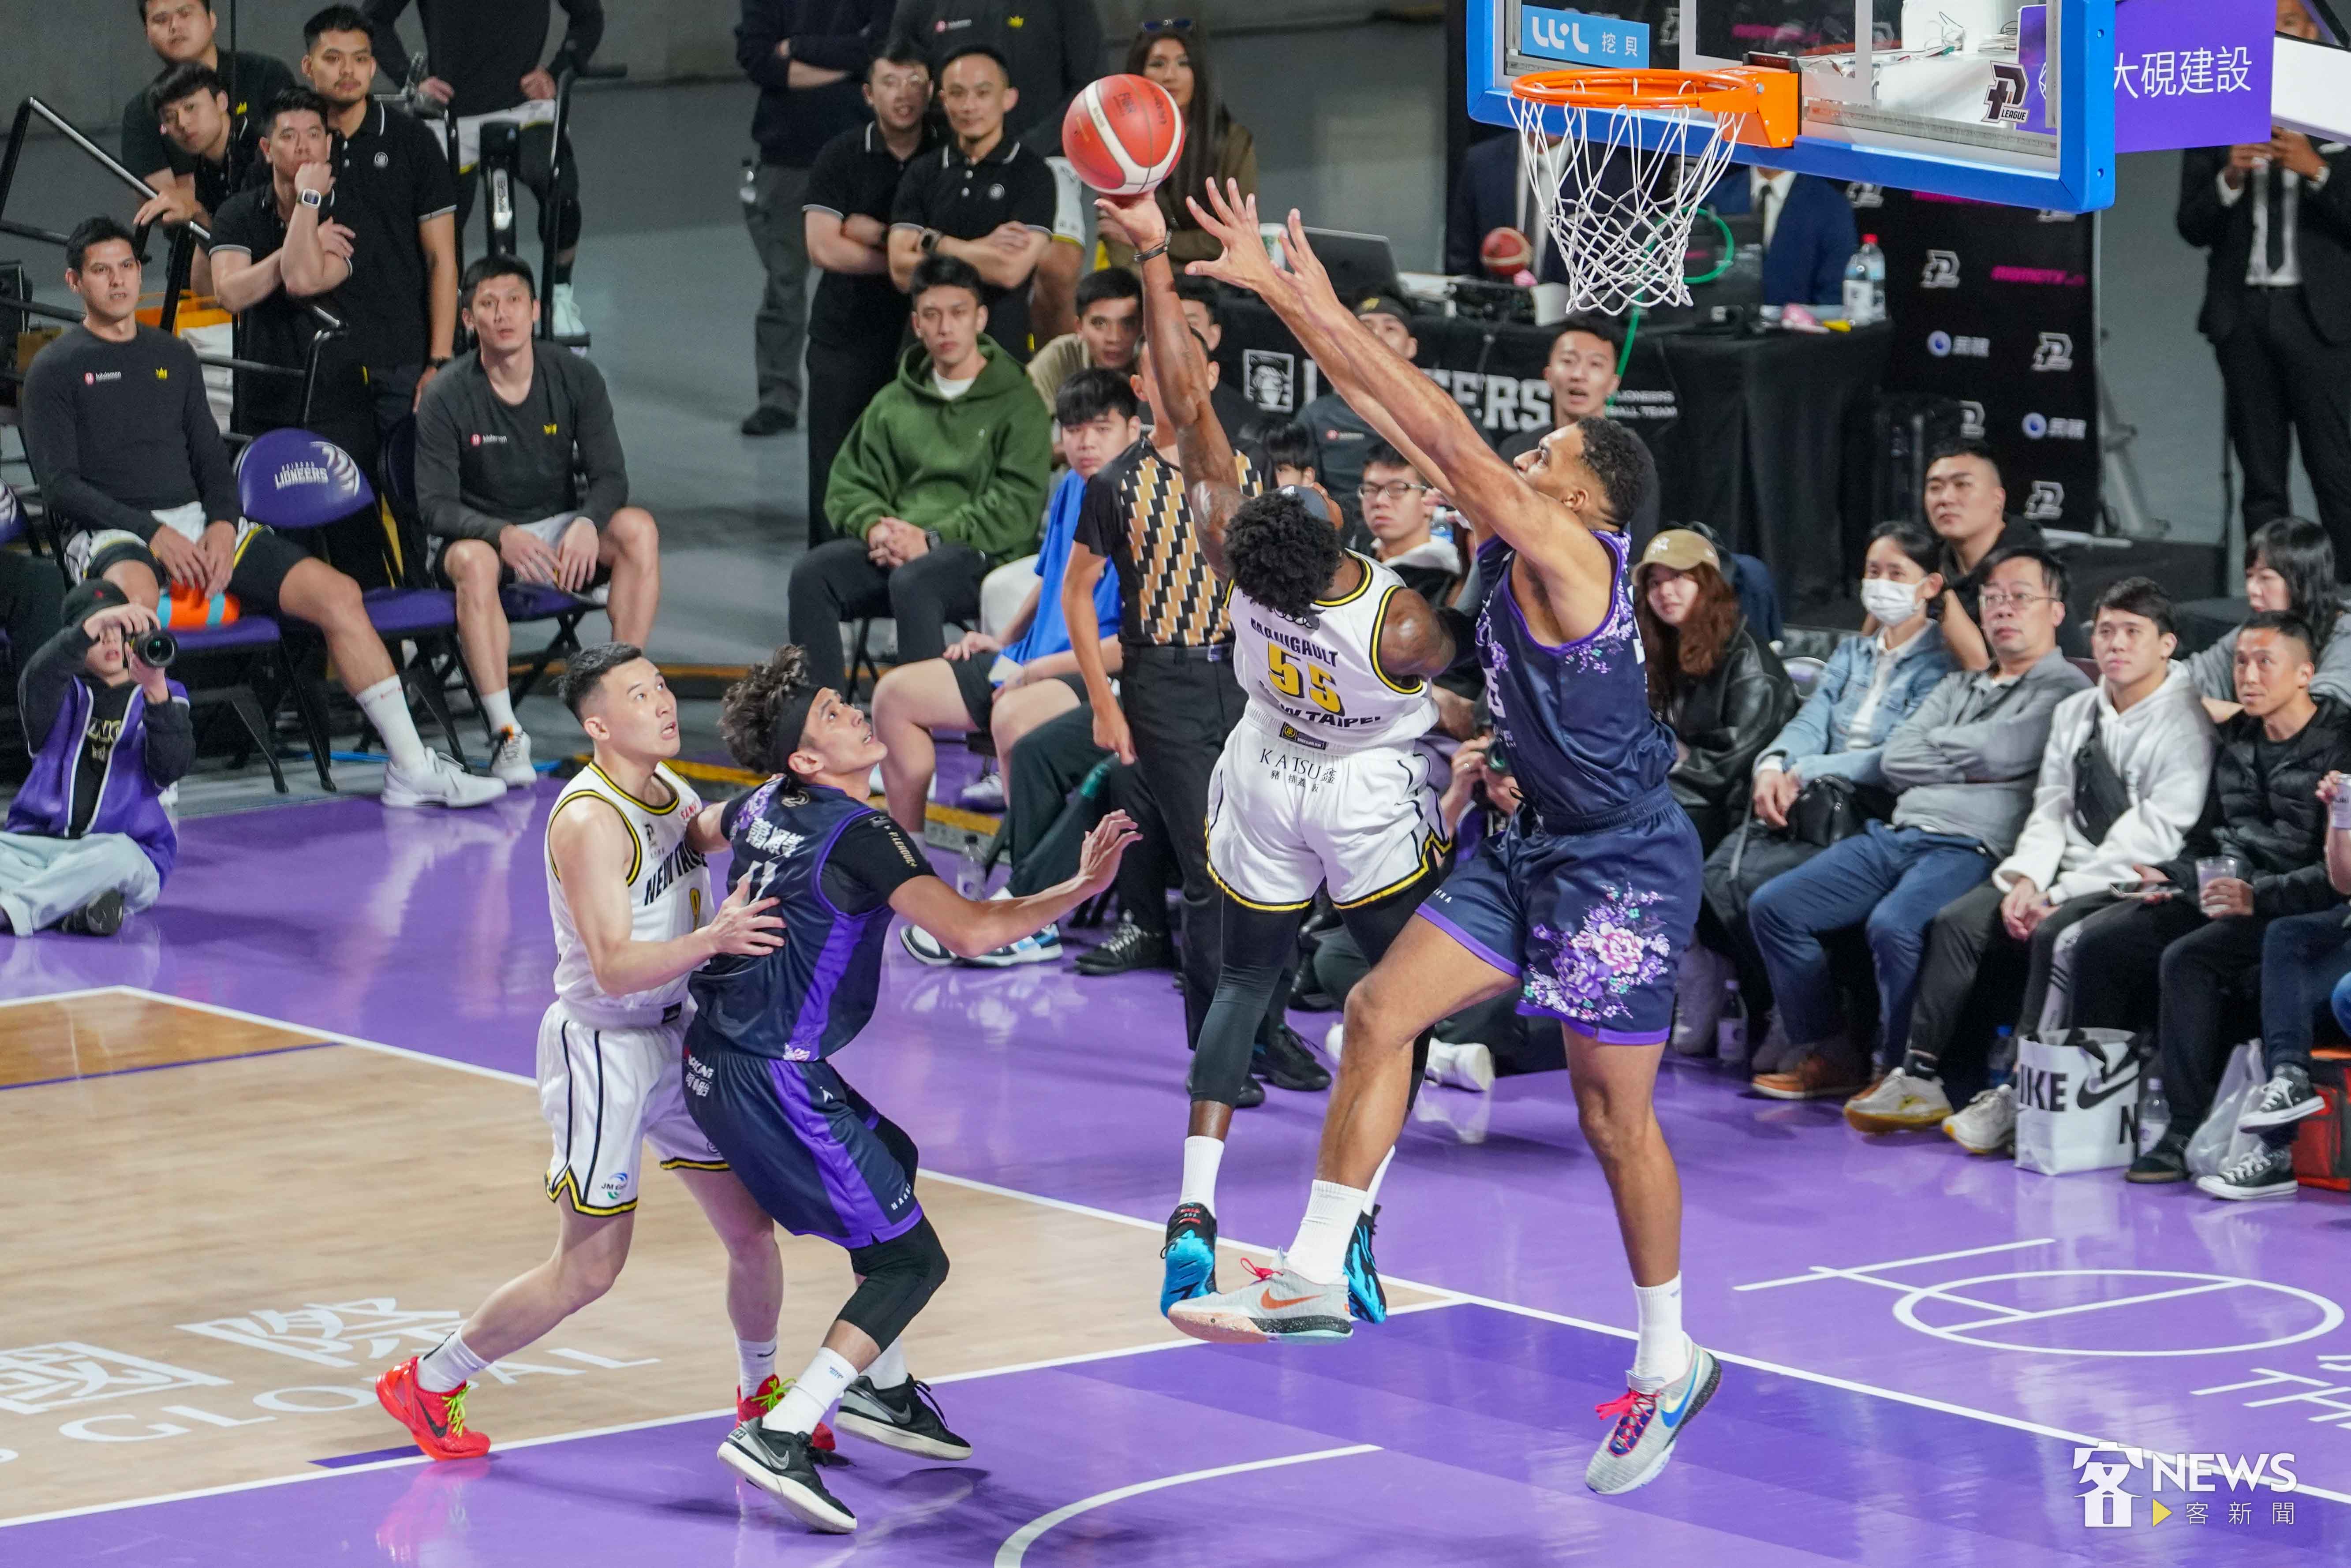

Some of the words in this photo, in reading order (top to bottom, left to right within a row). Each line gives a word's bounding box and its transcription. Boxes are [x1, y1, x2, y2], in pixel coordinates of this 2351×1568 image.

[1602, 31, 1637, 56] 挖貝
[2114, 45, 2252, 99] 大硯建設
[2001, 108, 2026, 120] LEAGUE
[274, 467, 329, 490] LIONEERS
[1268, 641, 1345, 717] 55
[1260, 749, 1321, 780] KATSU
[58, 1348, 662, 1442] GLOAL
